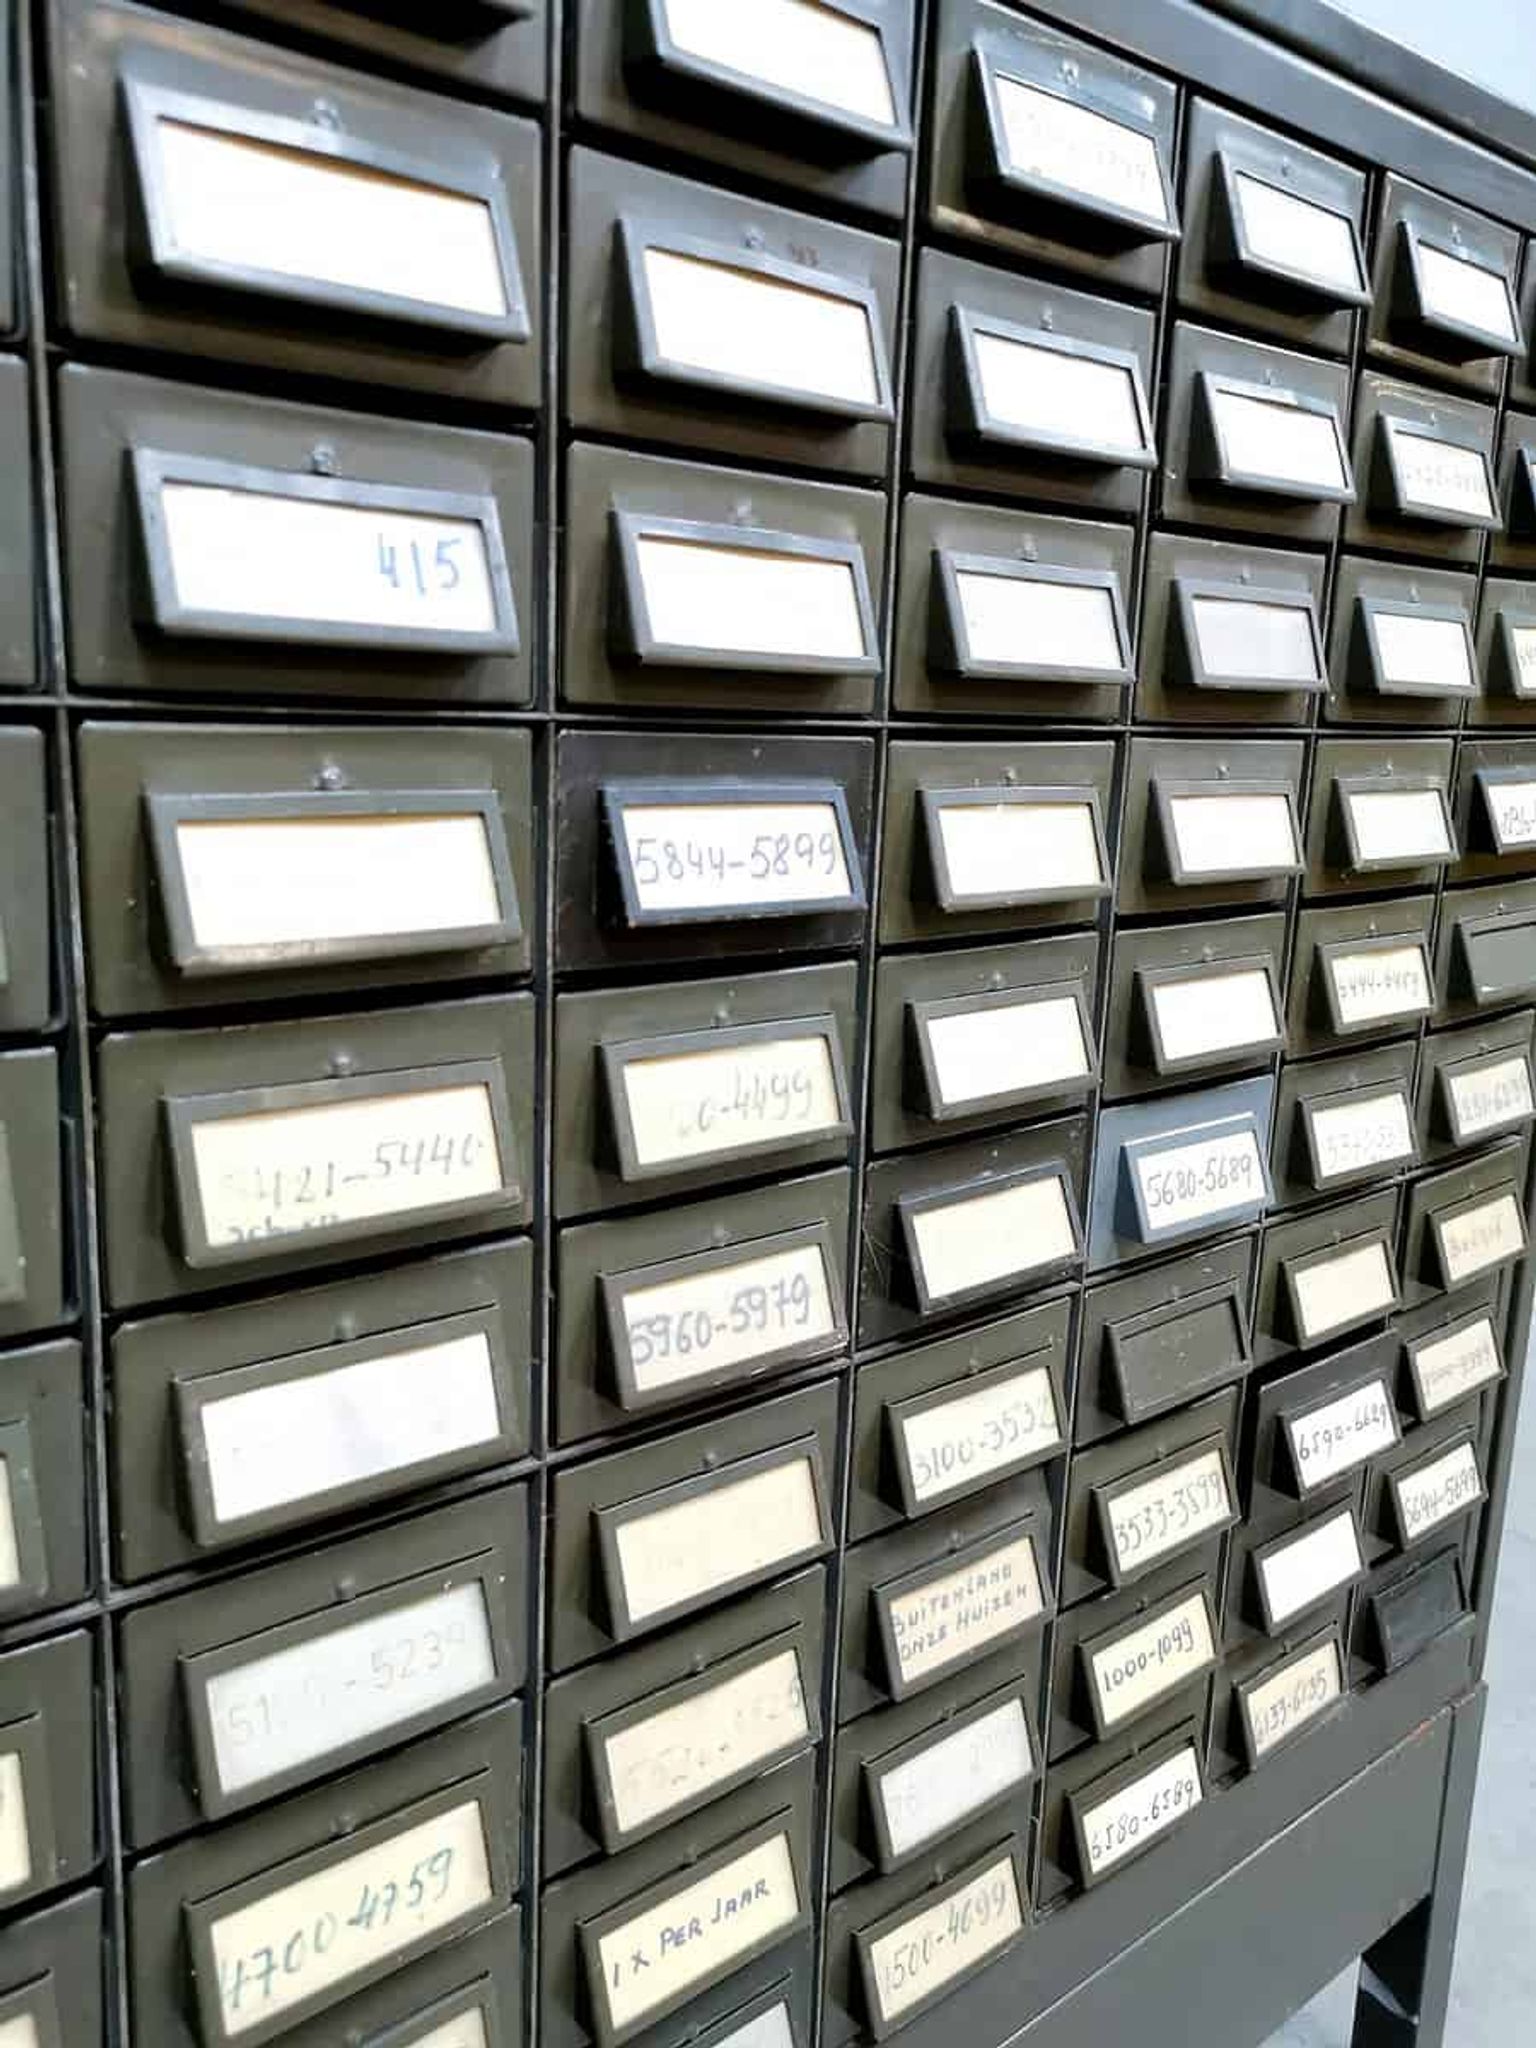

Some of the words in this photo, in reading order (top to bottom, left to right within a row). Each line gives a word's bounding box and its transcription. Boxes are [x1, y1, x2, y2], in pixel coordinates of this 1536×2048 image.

[379, 533, 461, 596] 415
[634, 832, 836, 884] 5844-5899
[1147, 1153, 1251, 1208] 5680-5689
[630, 1272, 811, 1367] 5960-5979
[1104, 1617, 1195, 1692] 1000-1099
[1092, 1778, 1195, 1860] 6580-6589
[660, 1919, 703, 1957] PER
[710, 1877, 771, 1924] JAAR
